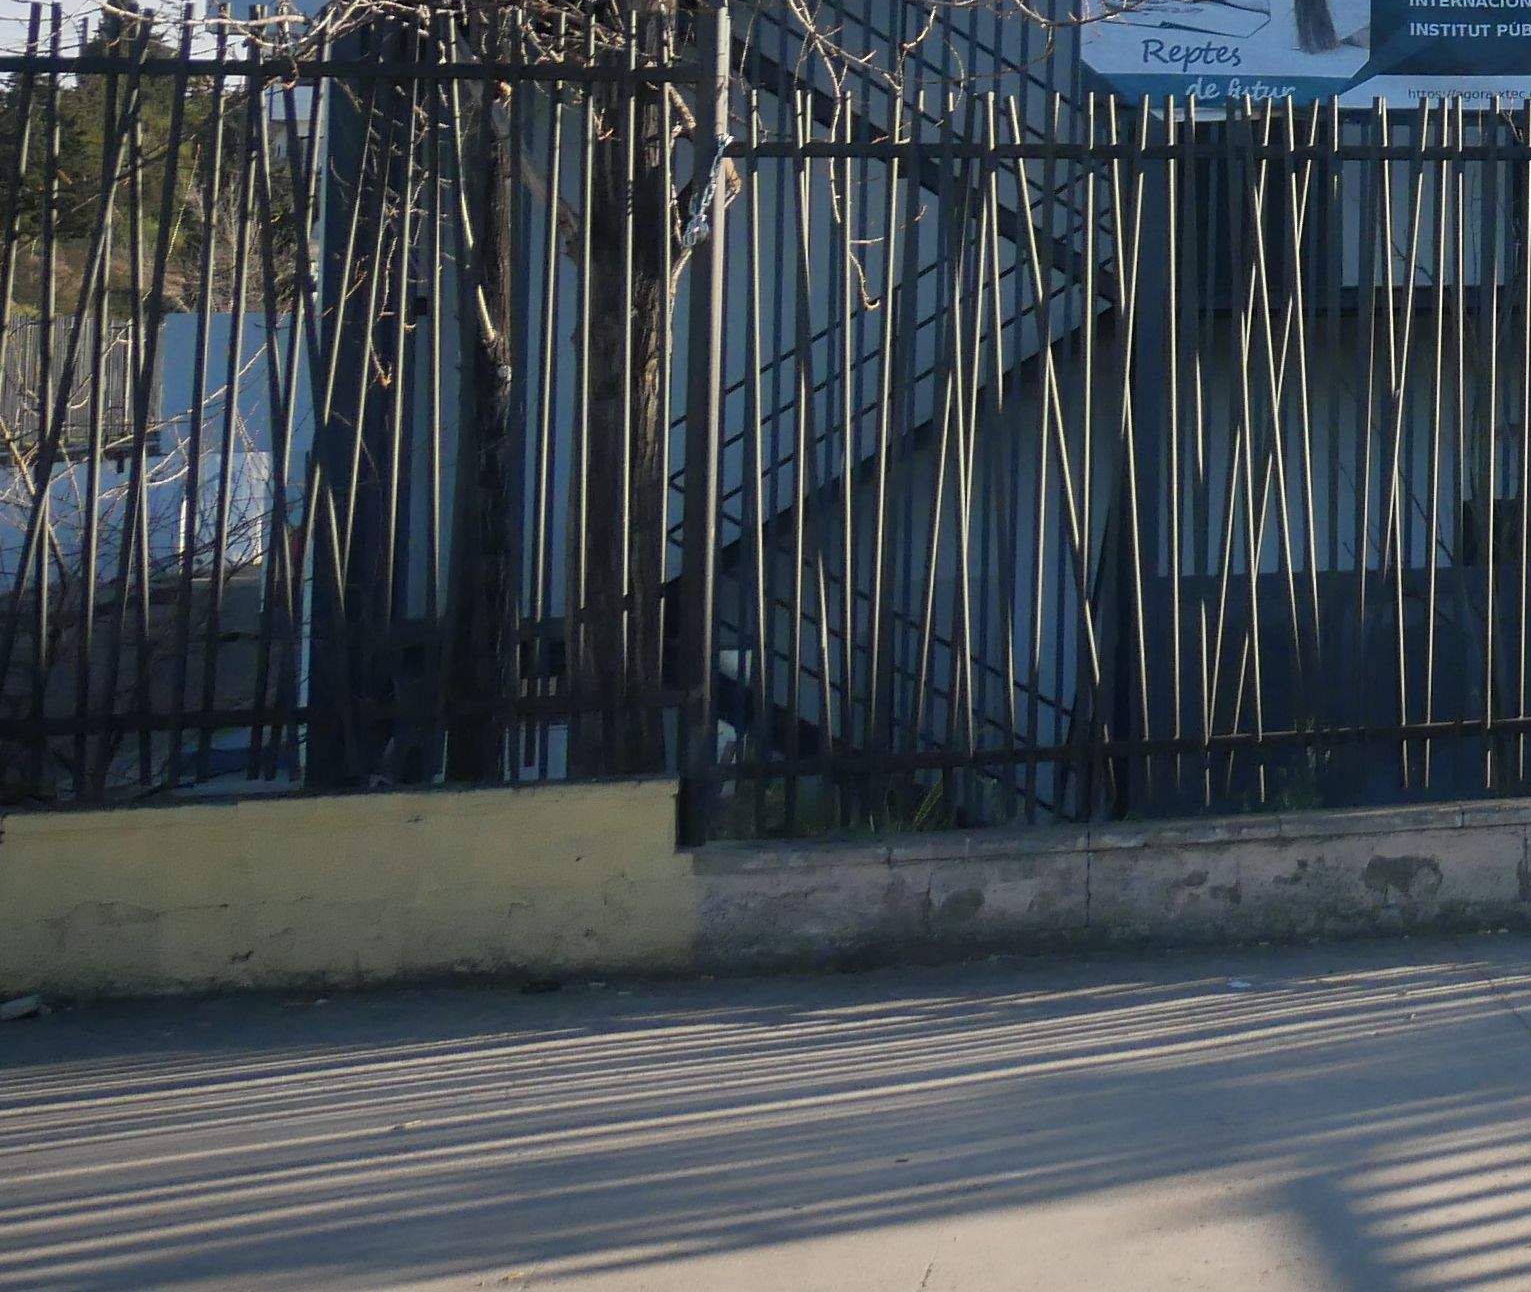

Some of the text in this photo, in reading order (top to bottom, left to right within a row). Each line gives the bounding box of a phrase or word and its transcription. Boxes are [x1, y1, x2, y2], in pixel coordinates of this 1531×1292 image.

[1409, 22, 1490, 38] INSTITUT
[1141, 38, 1242, 73] Reptes
[1185, 77, 1220, 100] de
